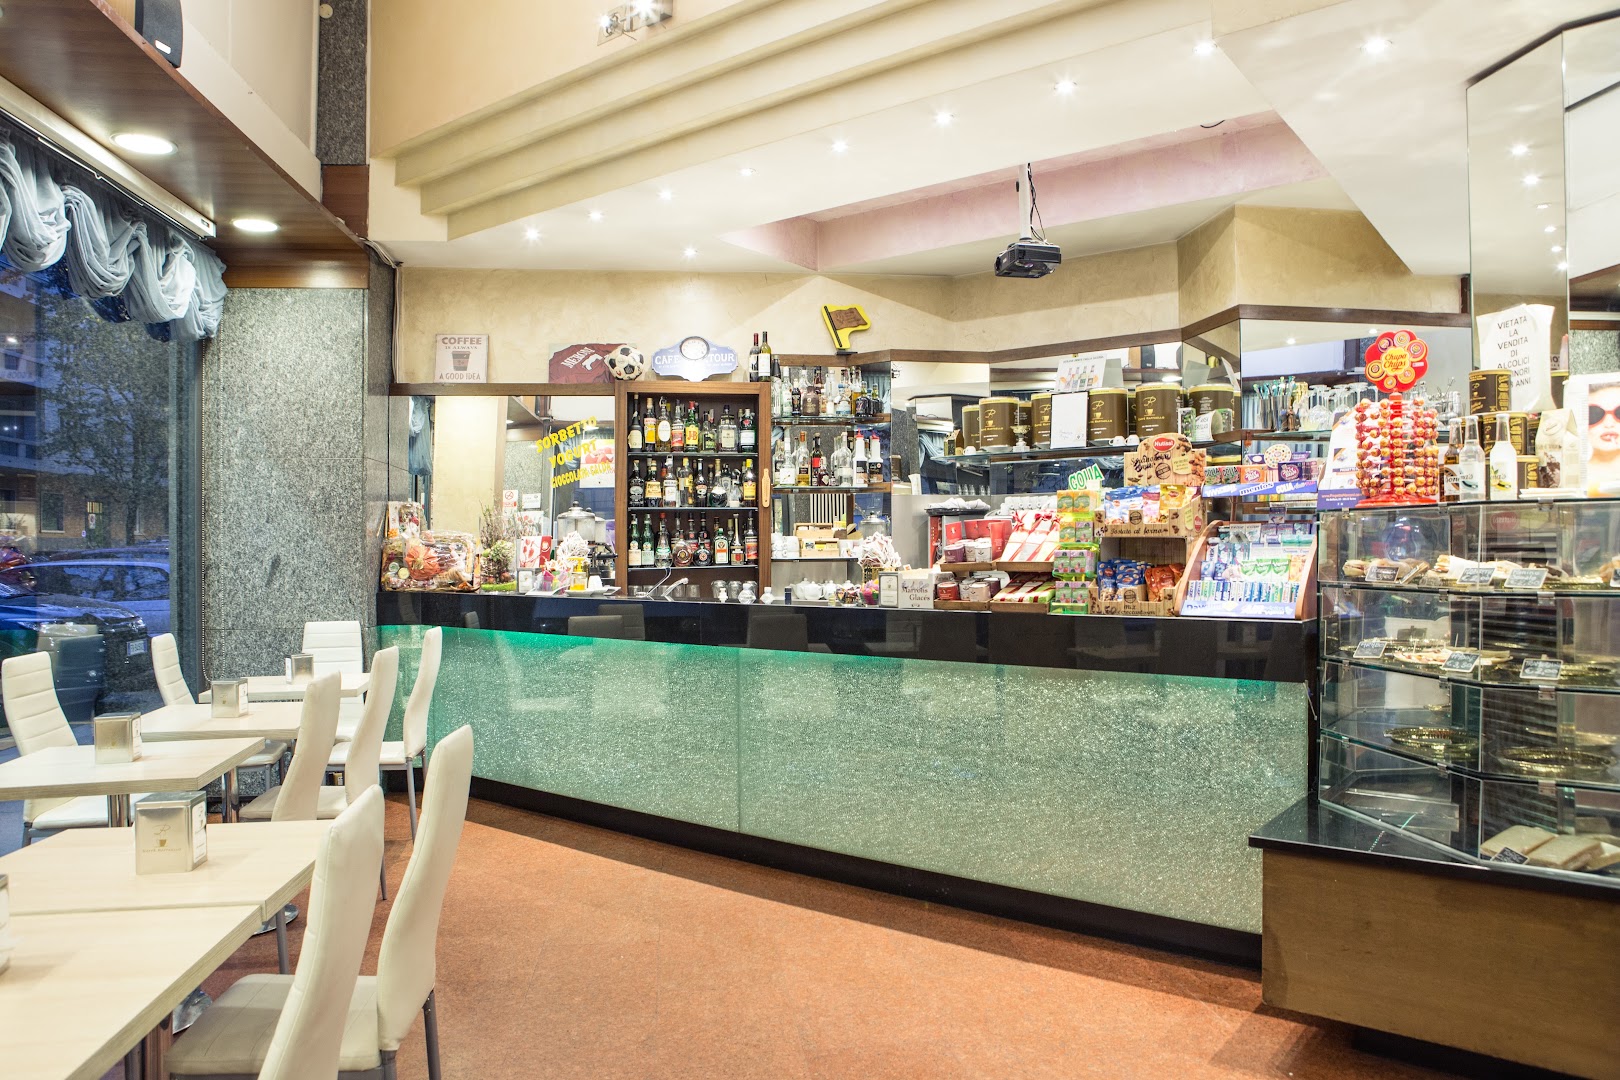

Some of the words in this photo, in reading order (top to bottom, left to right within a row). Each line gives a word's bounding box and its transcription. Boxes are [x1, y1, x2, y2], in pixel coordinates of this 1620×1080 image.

[1497, 315, 1528, 330] VIETATA
[1509, 328, 1519, 338] LA
[441, 336, 482, 345] COFFEE
[1497, 336, 1529, 350] VENDITA
[709, 353, 735, 362] TOUR
[1384, 353, 1407, 361] Chupa
[1510, 349, 1518, 358] DI
[1383, 360, 1406, 369] Chups
[1497, 355, 1530, 369] ALCOLICI
[439, 372, 444, 380] A
[445, 372, 464, 380] GOOD
[465, 372, 481, 380] IDEA
[1515, 377, 1531, 388] ANNI
[535, 415, 597, 453] SORBETTO
[548, 438, 597, 469] YOGURT
[1240, 482, 1274, 495] mentos
[1133, 527, 1141, 535] al
[909, 593, 931, 601] Glacés
